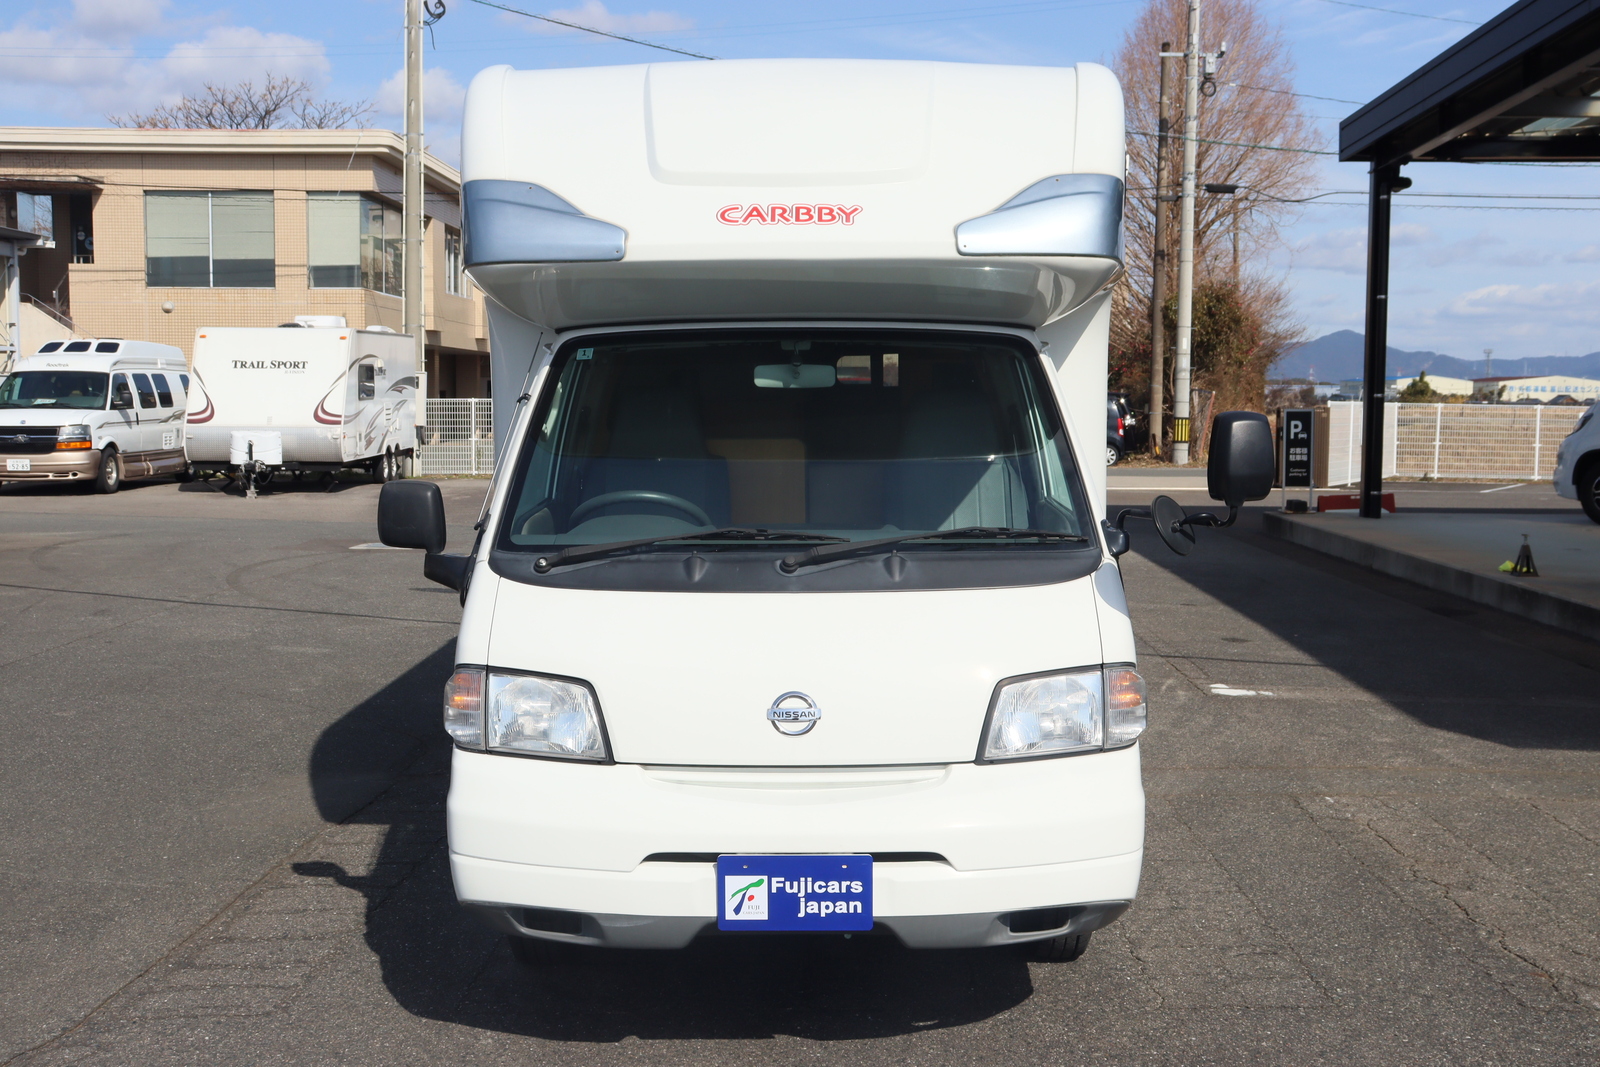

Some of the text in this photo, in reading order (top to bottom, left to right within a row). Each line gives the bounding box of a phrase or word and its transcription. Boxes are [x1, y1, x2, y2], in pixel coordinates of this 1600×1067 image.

[717, 204, 863, 226] CARBBY
[232, 360, 308, 370] TRAIL SPORT
[1290, 420, 1302, 439] P
[771, 877, 863, 897] Fujicars
[798, 897, 862, 917] japan
